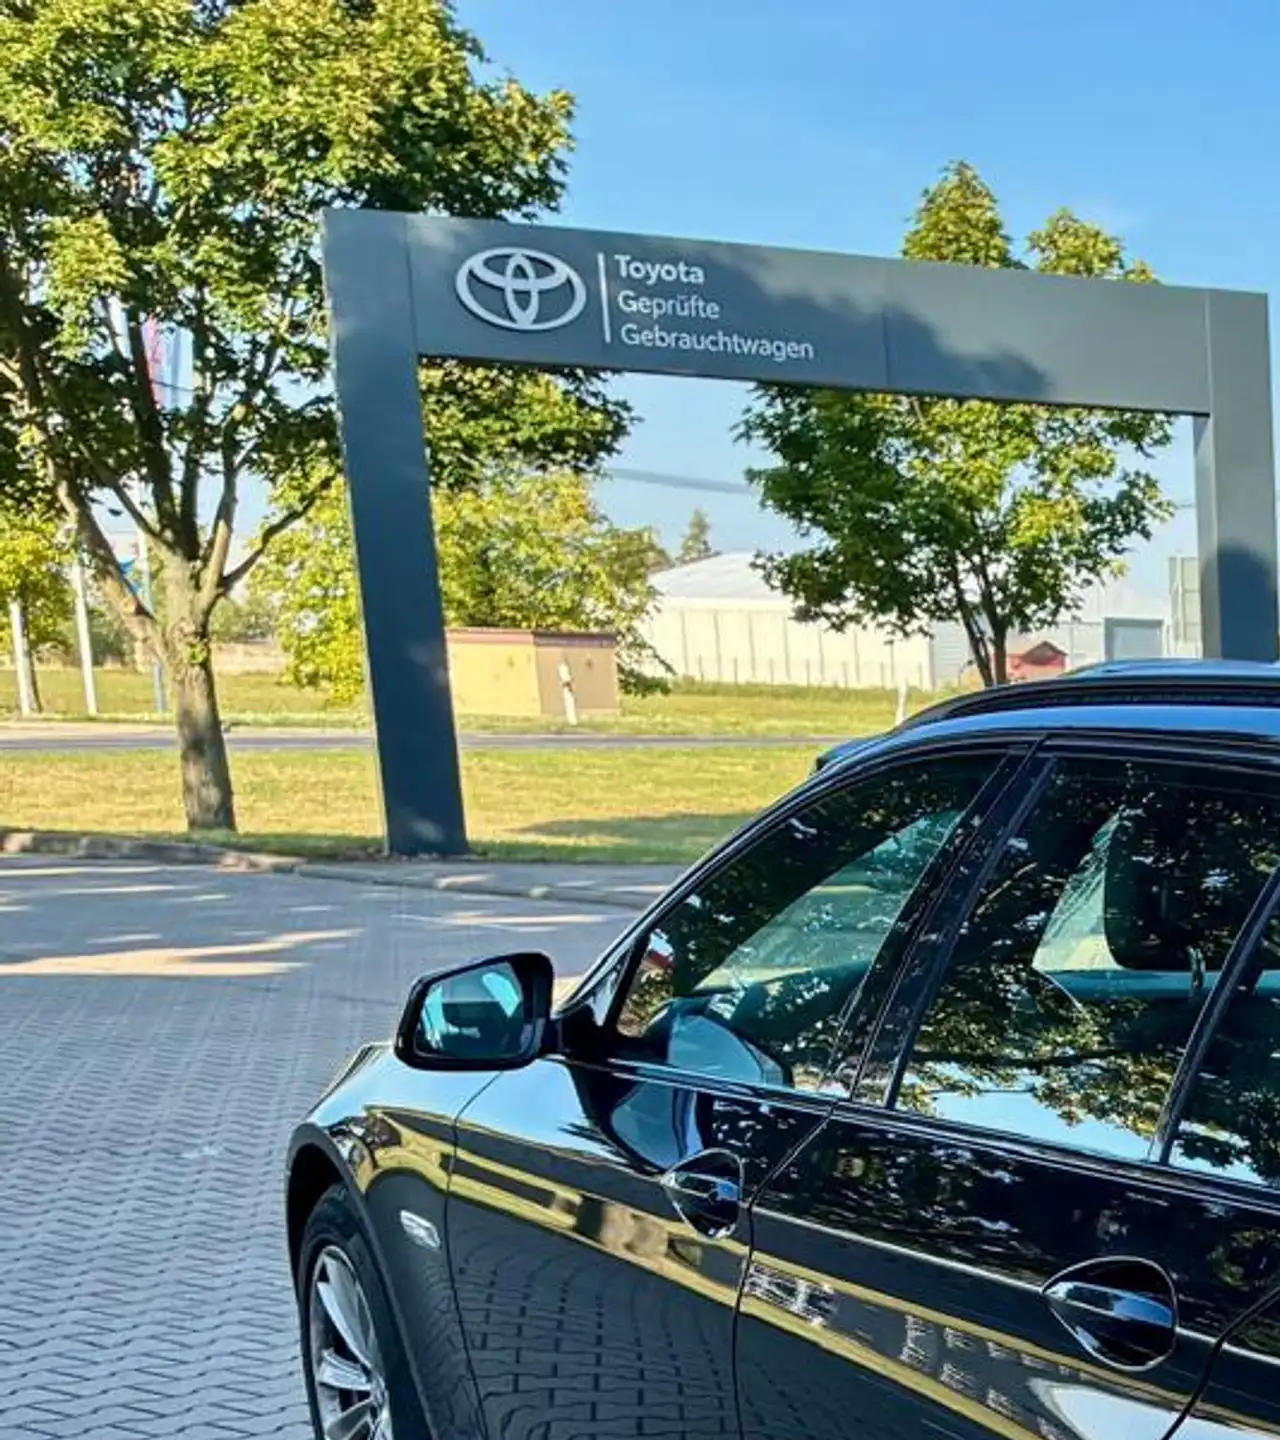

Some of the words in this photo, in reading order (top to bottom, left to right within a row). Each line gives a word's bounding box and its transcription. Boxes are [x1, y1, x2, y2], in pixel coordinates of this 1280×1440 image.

[613, 254, 705, 286] Toyota
[617, 290, 720, 321] Geprüfte
[621, 323, 815, 361] Gebrauchtwagen
